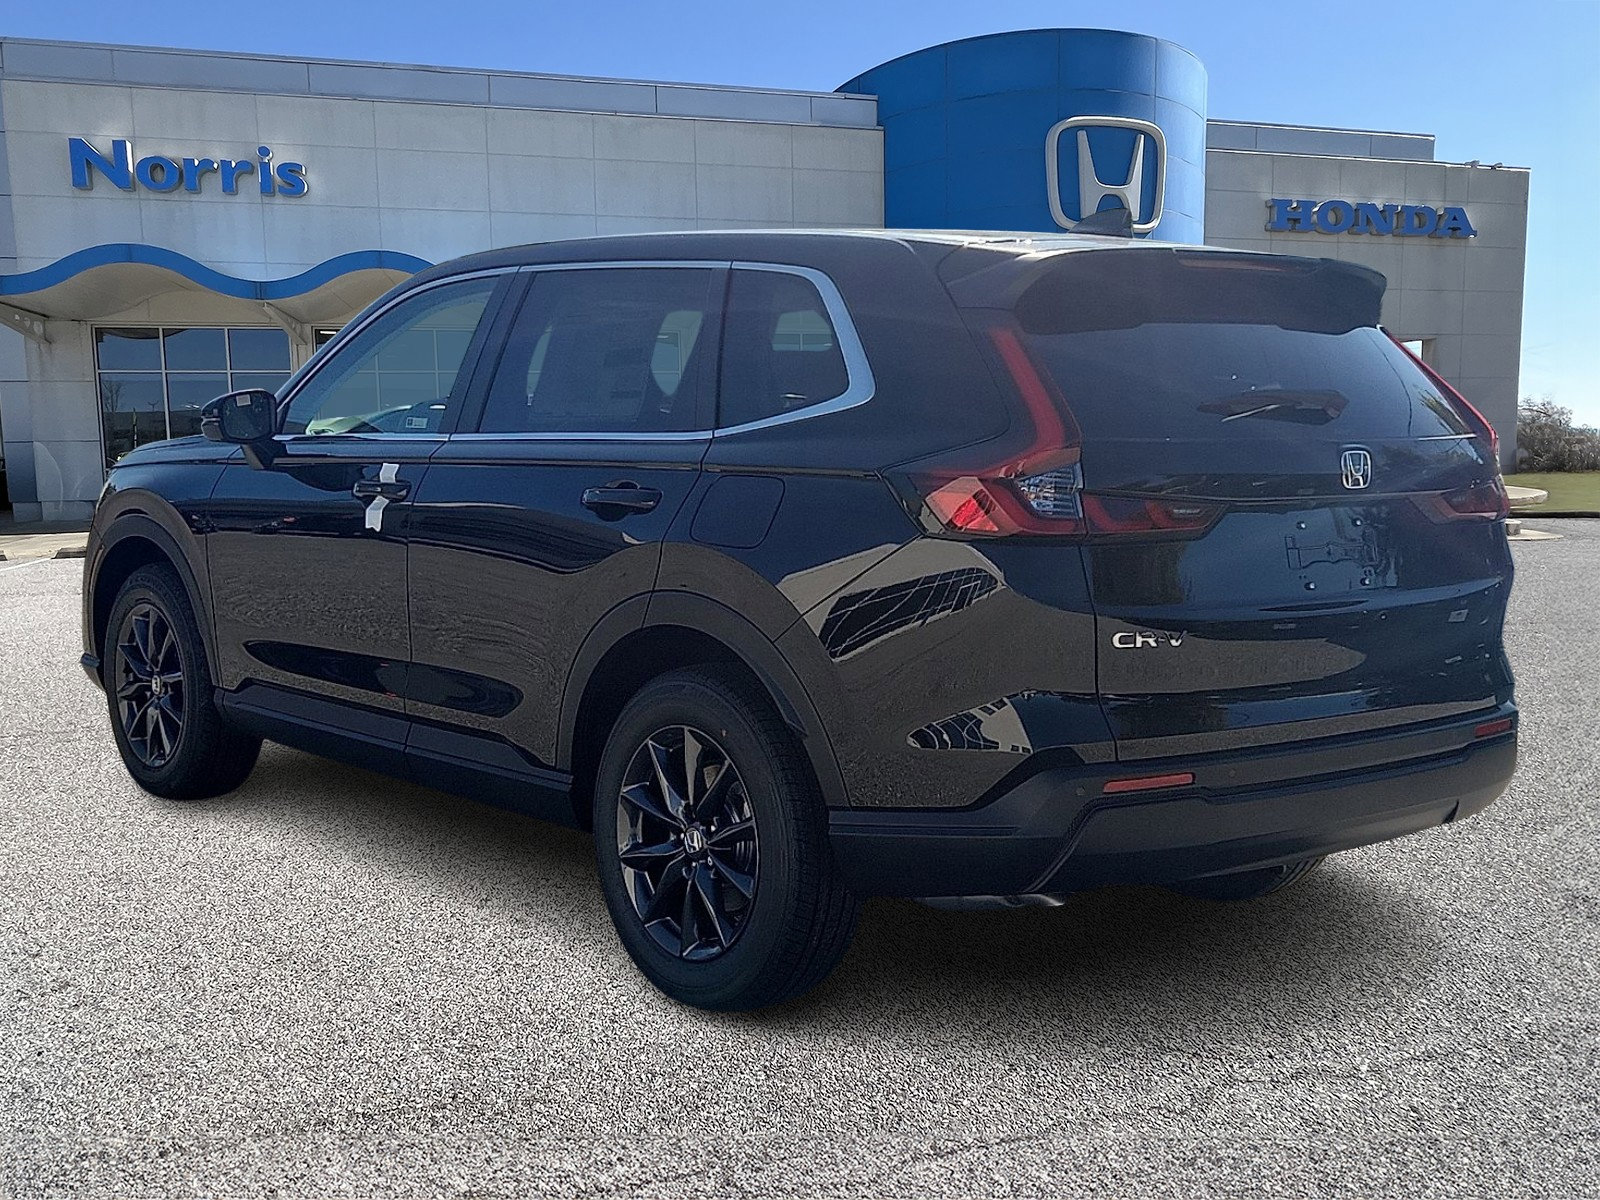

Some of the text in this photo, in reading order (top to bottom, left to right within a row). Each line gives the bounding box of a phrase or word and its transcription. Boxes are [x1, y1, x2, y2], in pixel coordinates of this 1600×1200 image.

[68, 137, 308, 196] Norris
[1266, 198, 1477, 239] HONDA
[1112, 630, 1187, 648] CR-V
